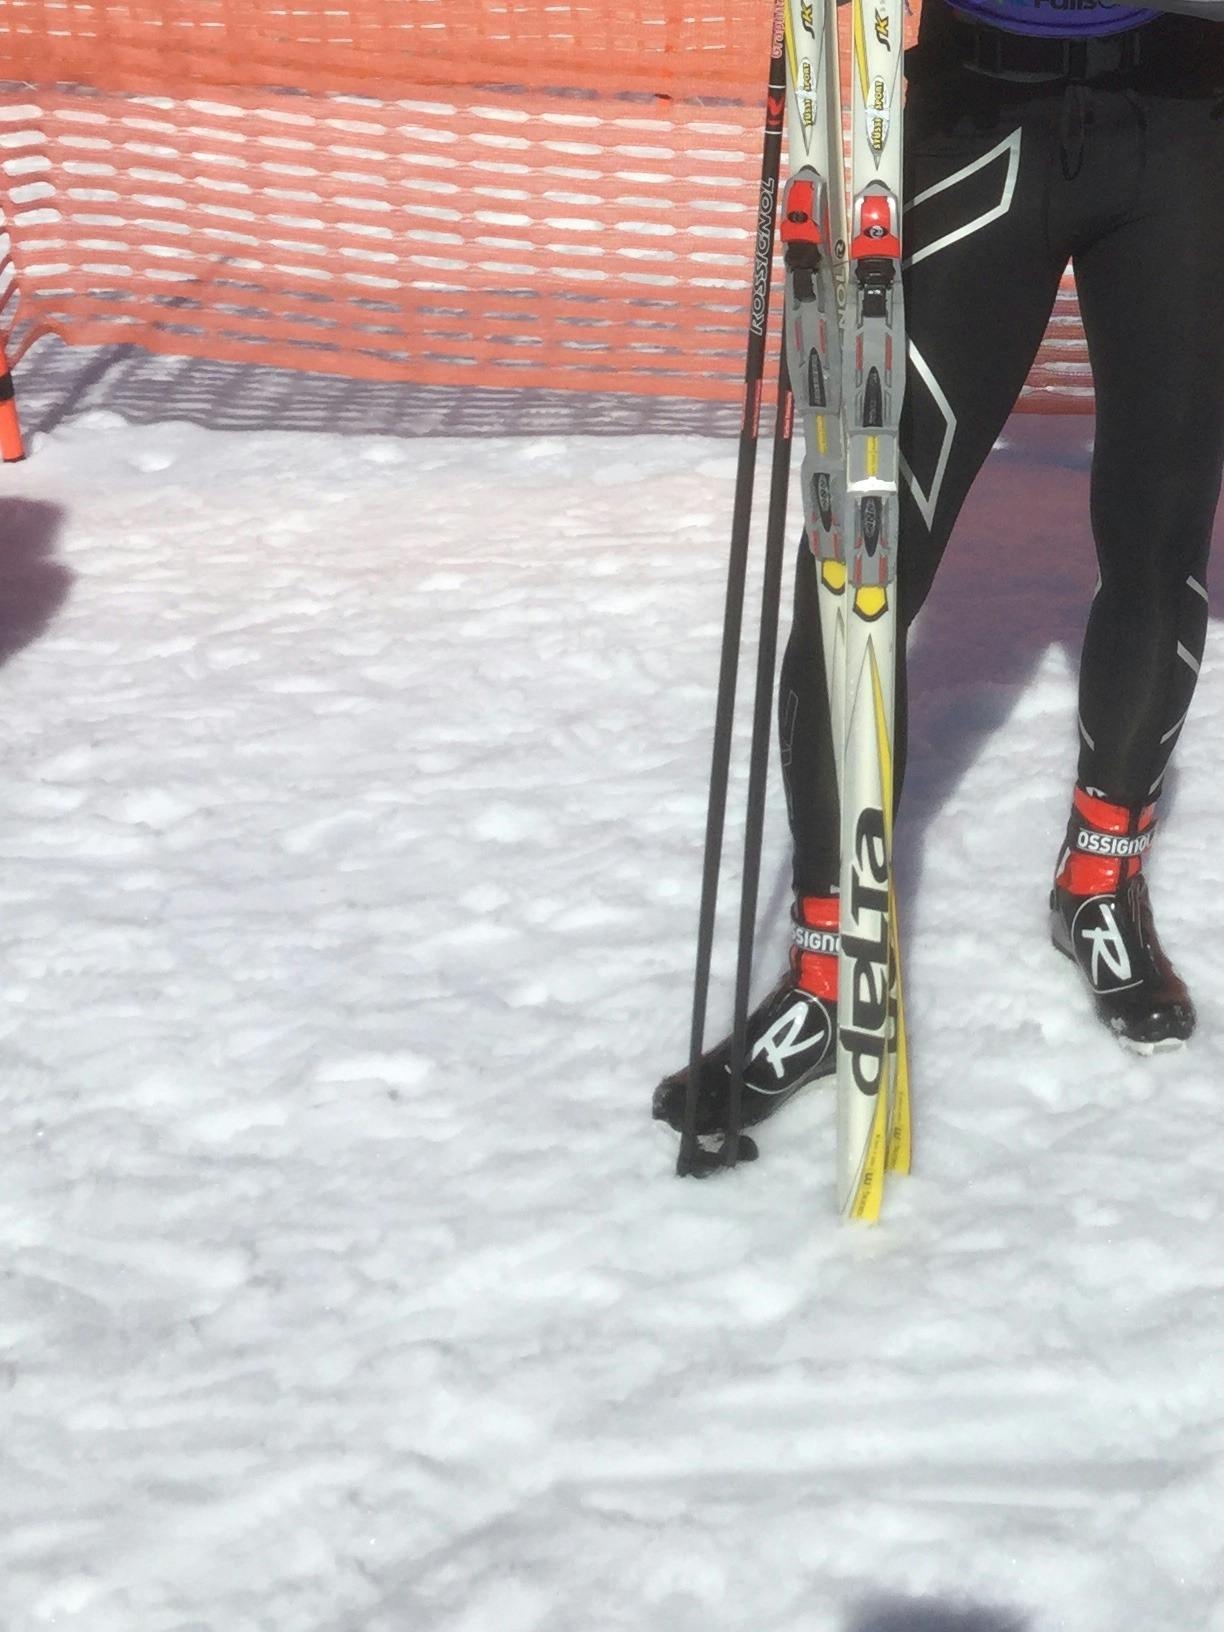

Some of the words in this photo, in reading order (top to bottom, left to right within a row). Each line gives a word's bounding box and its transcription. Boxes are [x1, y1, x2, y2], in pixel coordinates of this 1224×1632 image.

[874, 79, 886, 112] SPORT
[750, 177, 775, 337] ROSSIGNOL
[1077, 830, 1153, 855] OSSIGNOL
[791, 926, 841, 953] SIGN
